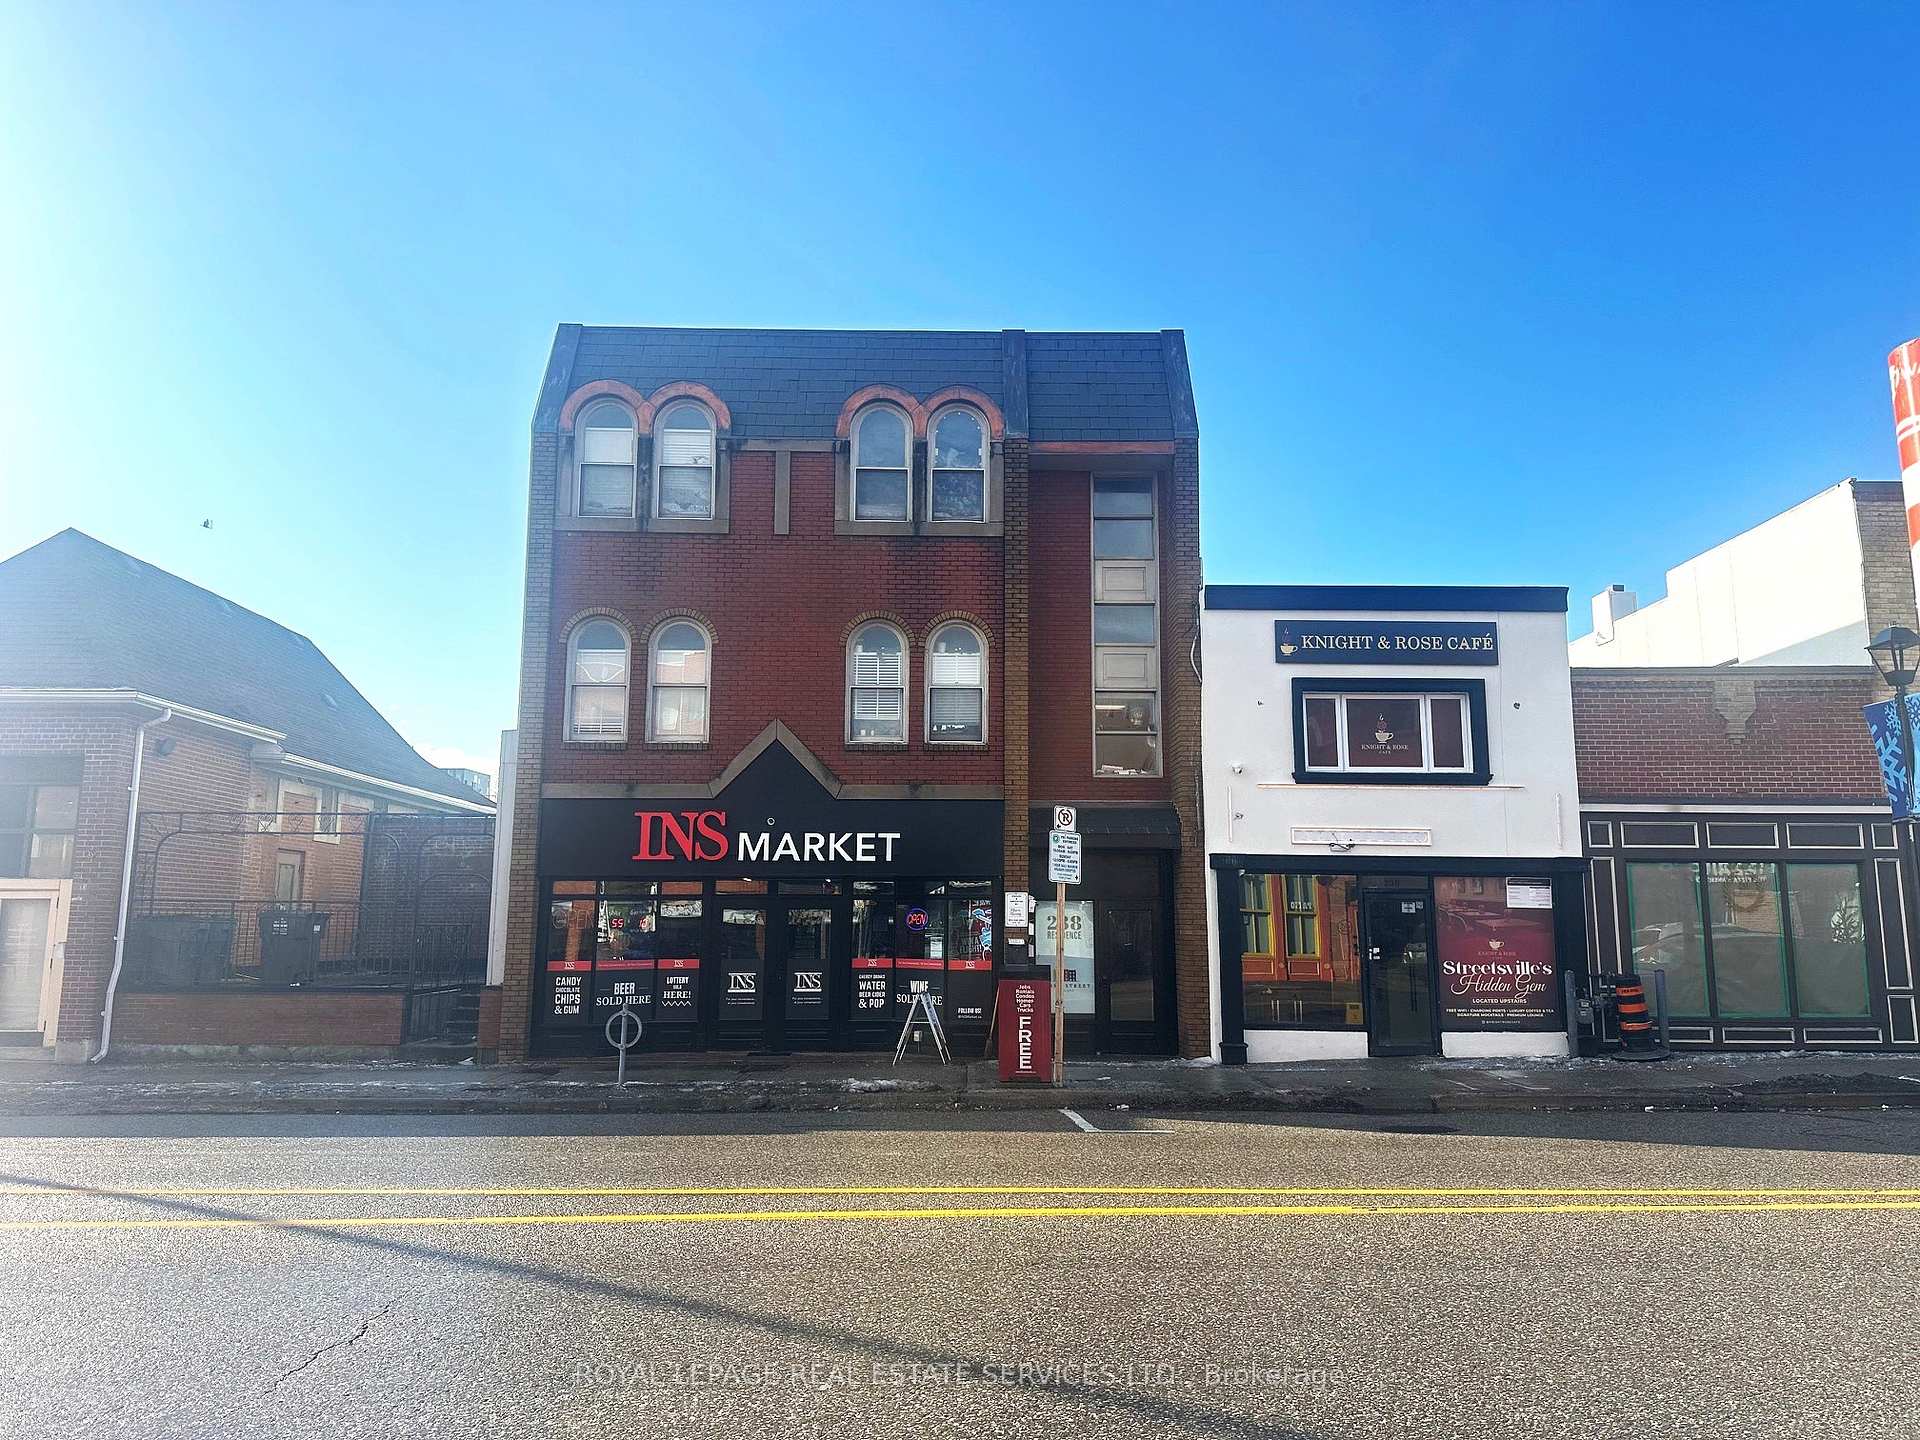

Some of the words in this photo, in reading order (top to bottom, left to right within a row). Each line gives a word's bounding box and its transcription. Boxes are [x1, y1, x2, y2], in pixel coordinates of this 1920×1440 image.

[1301, 634, 1374, 650] KNIGHT
[1377, 637, 1391, 650] &
[1395, 636, 1443, 651] ROSE
[1447, 633, 1494, 651] CAFÉ
[632, 811, 729, 861] INS
[738, 832, 900, 861] MARKET
[908, 913, 926, 925] OPEN
[1442, 960, 1553, 975] Streetsville's
[556, 977, 582, 986] CANDY
[666, 976, 689, 985] LOTTERY
[728, 973, 757, 992] INS
[794, 972, 822, 992] INS
[859, 981, 886, 991] WATER
[910, 980, 929, 993] WINE
[1450, 973, 1512, 995] Hidden
[1514, 973, 1547, 999] Gem
[614, 983, 635, 995] BEER
[663, 990, 691, 999] HERE!
[555, 994, 581, 1004] CHIPS
[596, 996, 623, 1006] SOLD
[625, 995, 651, 1005] HERE
[858, 999, 867, 1008] &
[869, 999, 885, 1008] POP
[555, 1005, 562, 1014] &
[564, 1005, 580, 1014] GUM
[1018, 1016, 1032, 1069] FREE
